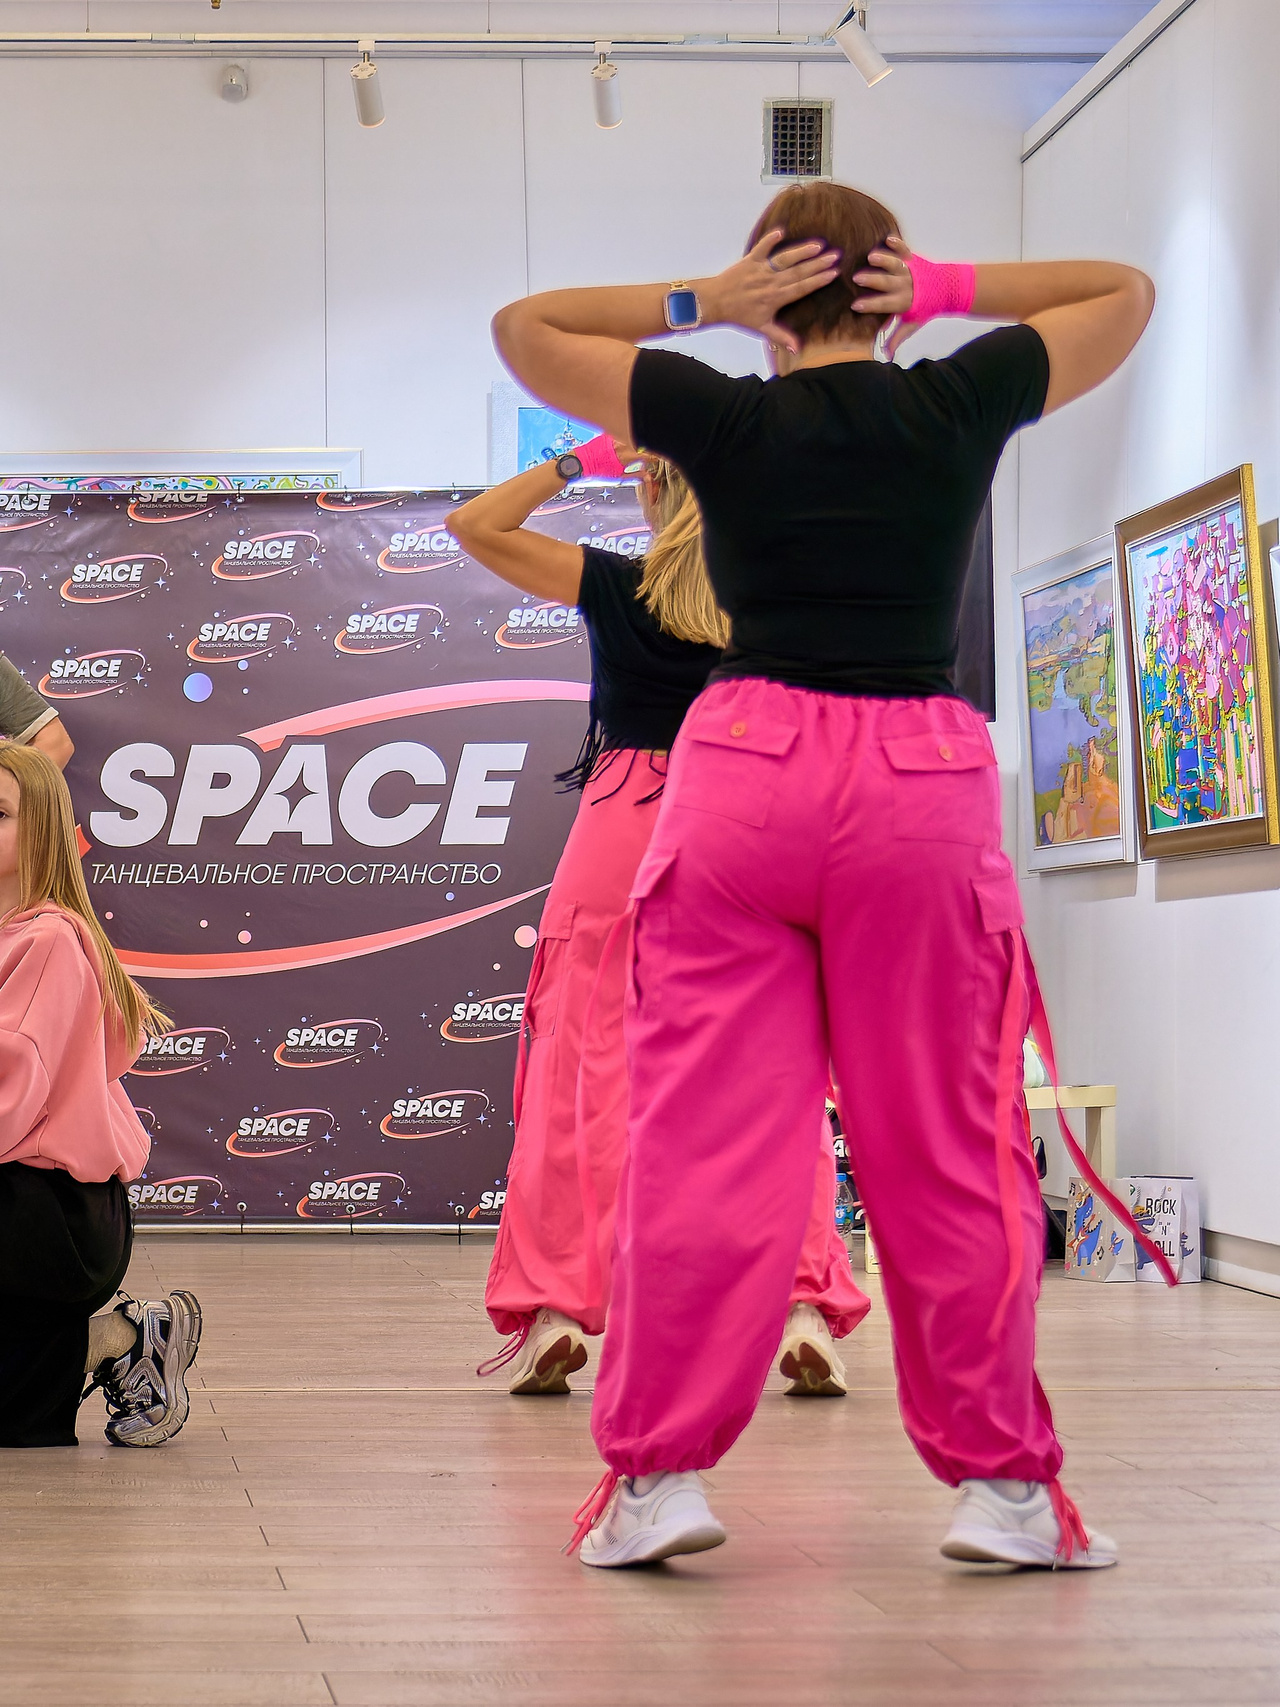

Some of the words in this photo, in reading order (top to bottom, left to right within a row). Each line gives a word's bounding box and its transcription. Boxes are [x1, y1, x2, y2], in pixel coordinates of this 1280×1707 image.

[223, 540, 296, 559] SPACE
[389, 533, 461, 552] SPACE
[72, 564, 144, 582] SPACE
[345, 614, 420, 633] SPACE
[506, 608, 579, 628] SPACE
[198, 623, 271, 641] SPACE
[49, 659, 122, 678] SPACE
[89, 742, 528, 847] SPACE
[91, 863, 287, 888] ТАНЦЕВАЛЬНОЕ
[291, 863, 502, 884] ПРОСТРАНСТВО
[452, 1003, 525, 1021] SPACE
[285, 1028, 359, 1047] SPACE
[391, 1099, 465, 1118] SPACE
[237, 1118, 311, 1136] SPACE
[128, 1185, 199, 1203] SPACE
[308, 1182, 381, 1200] SPACE
[1145, 1198, 1177, 1216] ROCK
[1153, 1240, 1175, 1257] OLL
